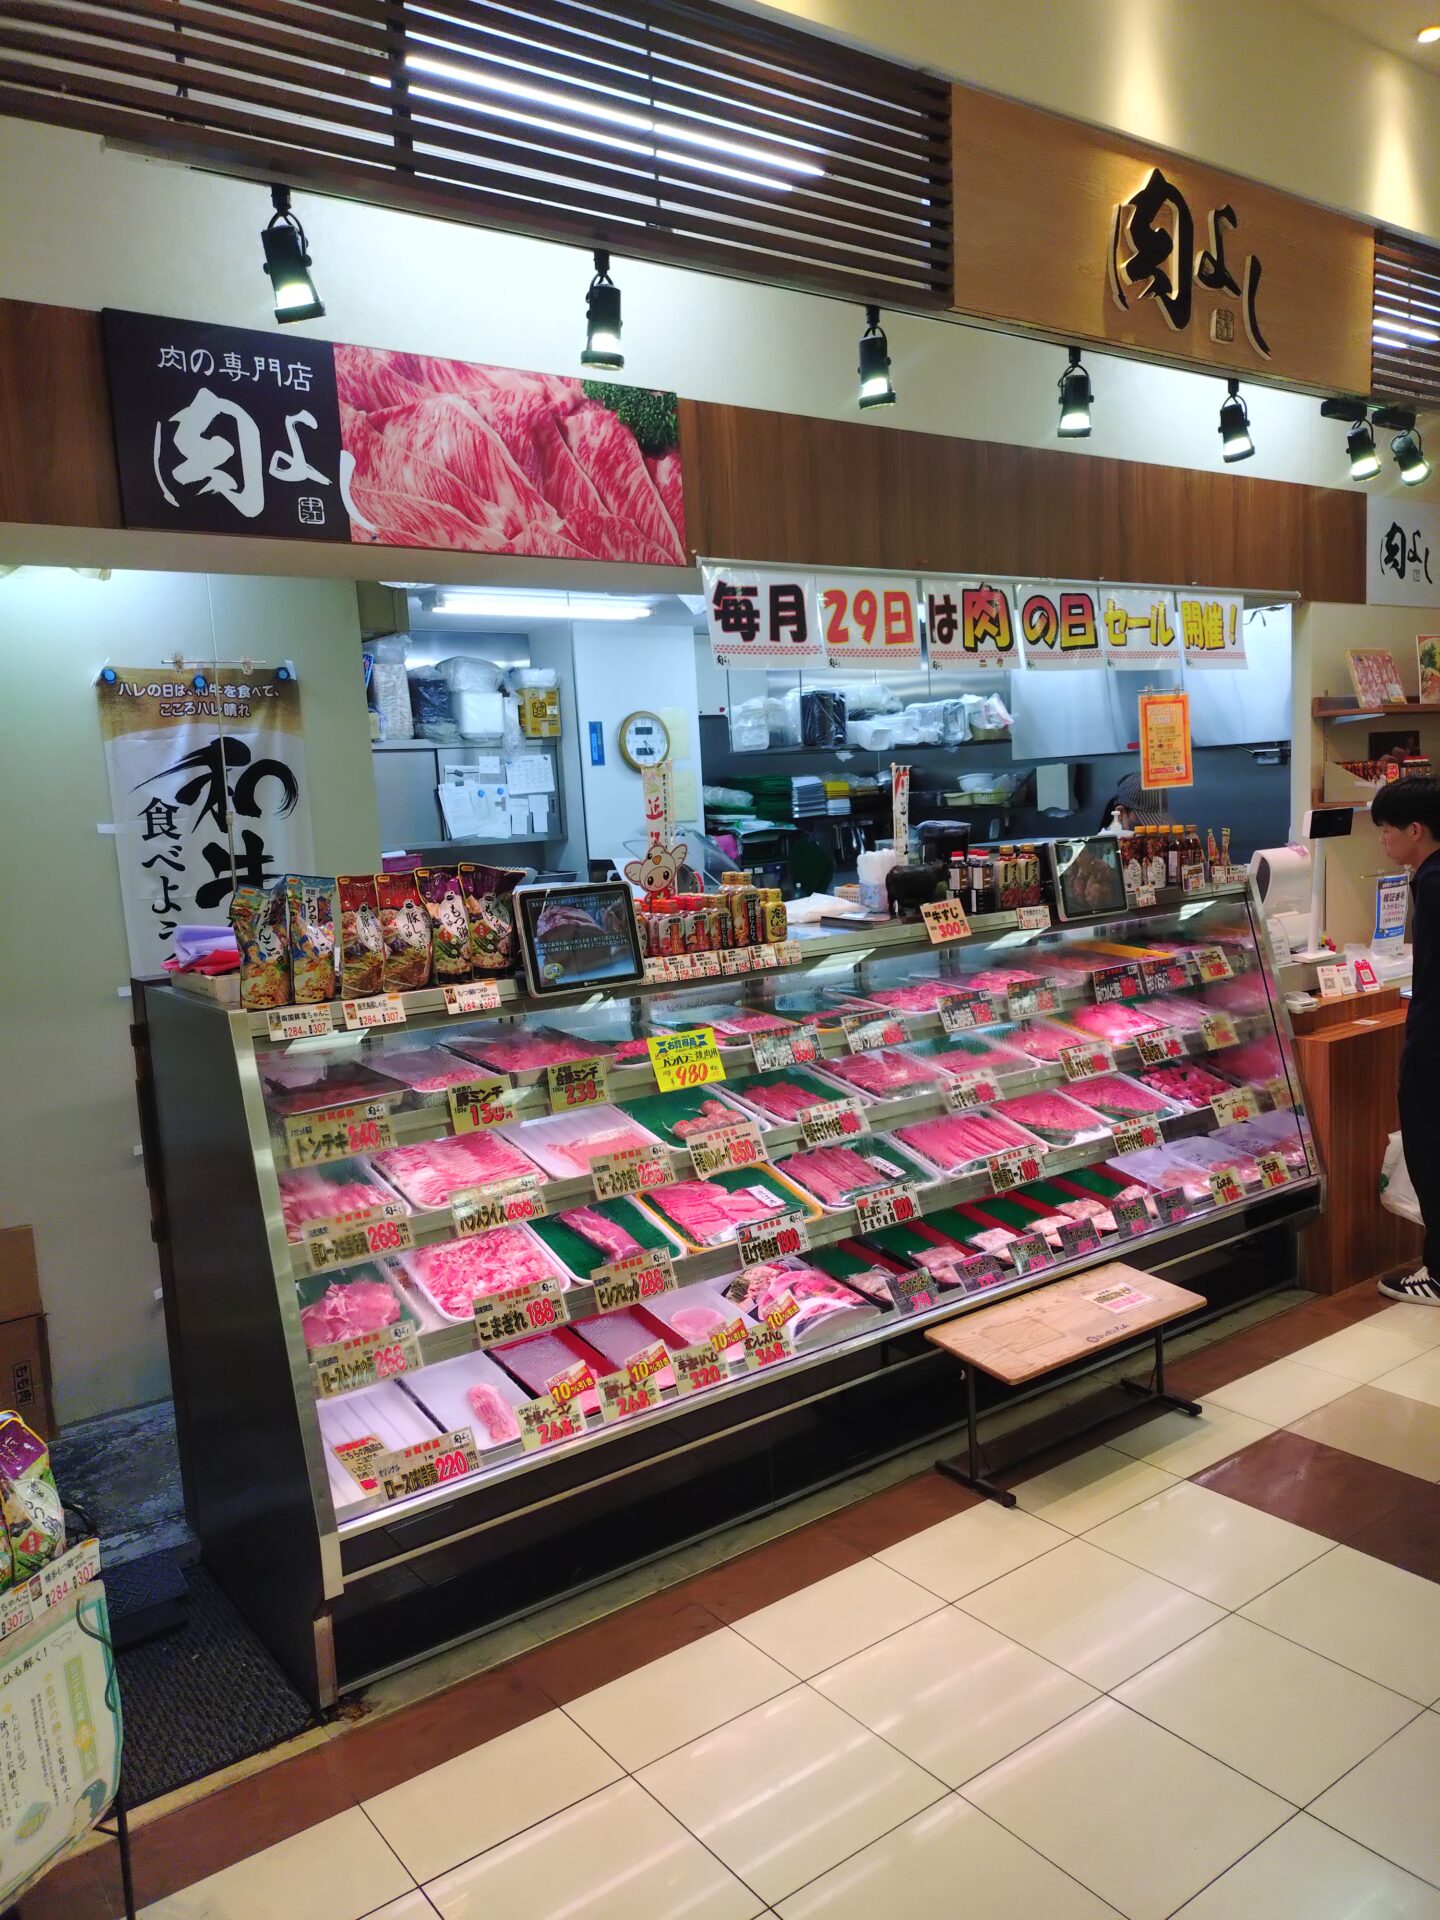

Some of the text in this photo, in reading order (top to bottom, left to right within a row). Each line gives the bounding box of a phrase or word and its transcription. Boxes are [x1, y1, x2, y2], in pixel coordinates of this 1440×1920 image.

[157, 347, 314, 391] 肉の専門店
[153, 388, 377, 540] 肉よし
[1380, 521, 1433, 585] 肉よし
[160, 702, 250, 717] こころハレ晴れ
[932, 907, 959, 923] 牛すじ
[938, 922, 961, 939] 300
[287, 1023, 326, 1037] 284 307
[363, 1012, 399, 1025] 284 307
[564, 1080, 598, 1105] 238
[347, 1121, 380, 1153] 240
[728, 1139, 756, 1165] 350
[366, 1222, 400, 1253] 268
[638, 1268, 664, 1297] 288
[480, 1309, 528, 1342] こまぎれ
[525, 1297, 555, 1328] 188
[754, 1344, 786, 1366] 368
[689, 1366, 721, 1389] 320
[616, 1390, 651, 1417] 268
[537, 1417, 574, 1445] 268
[435, 1450, 468, 1483] 220
[50, 1563, 94, 1606] 284 307
[6, 1611, 24, 1631] 307
